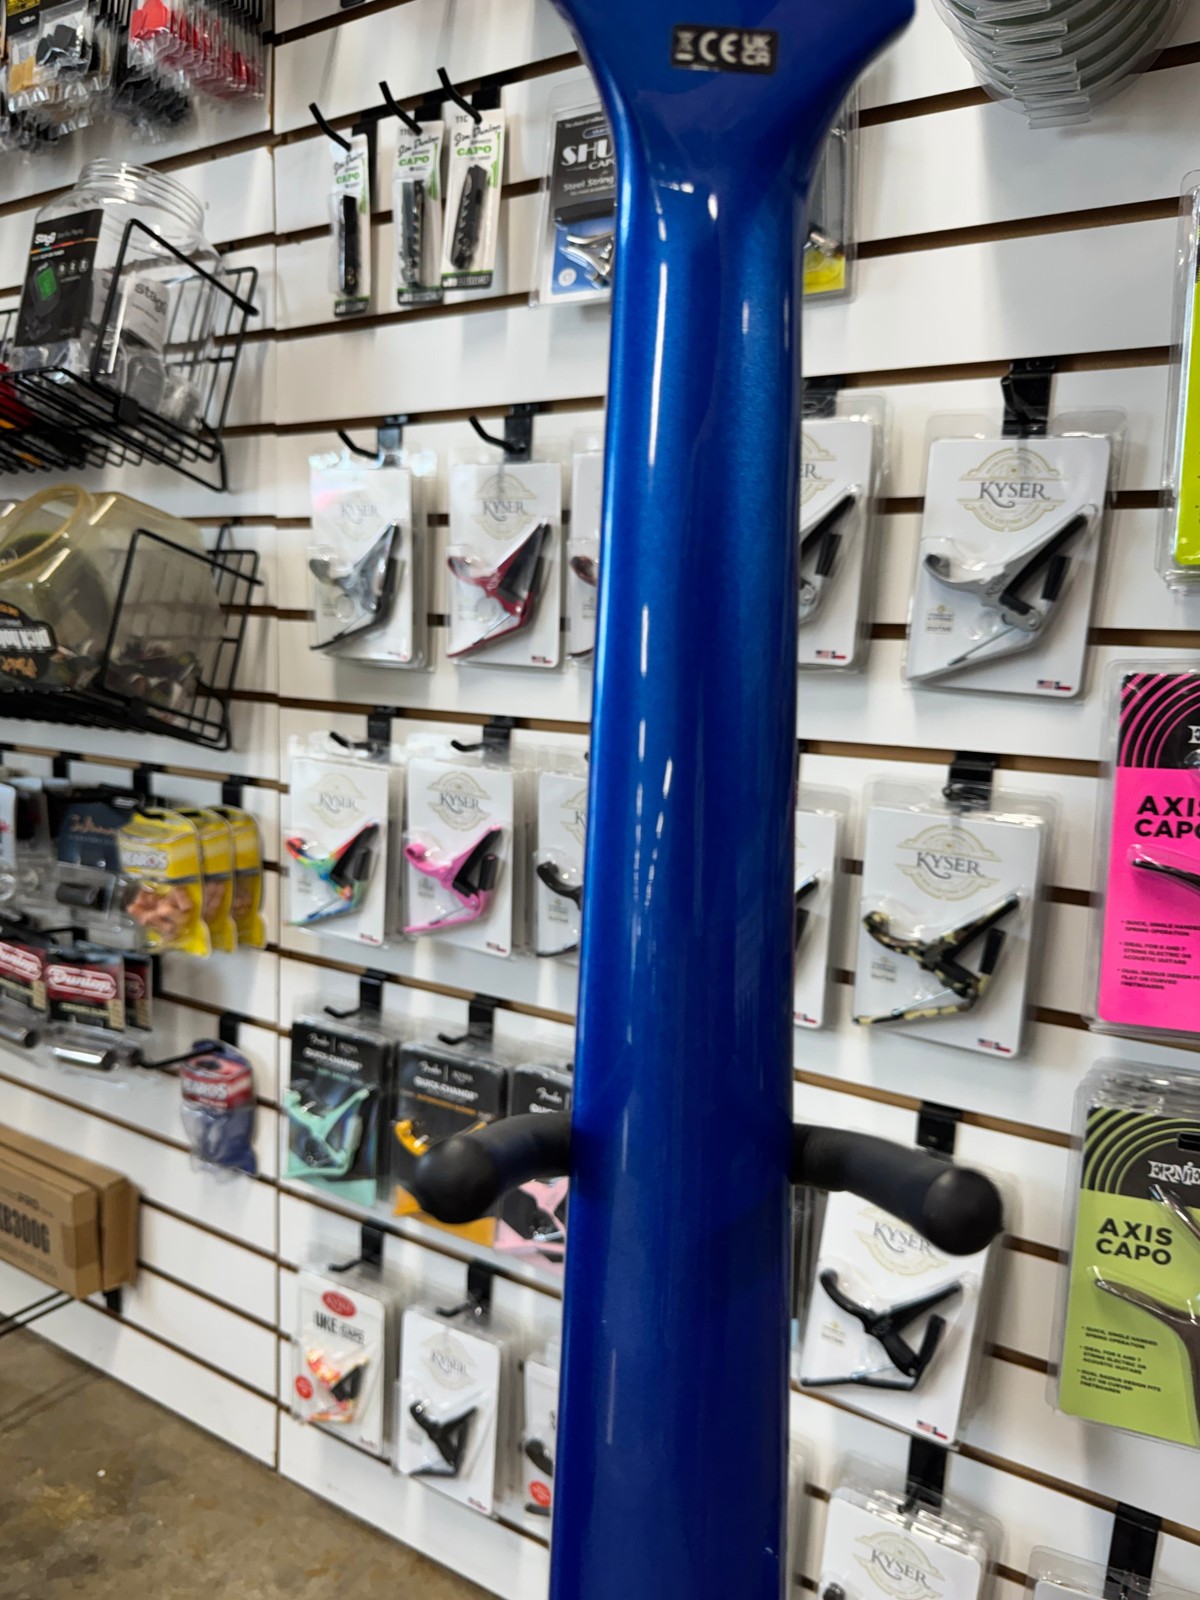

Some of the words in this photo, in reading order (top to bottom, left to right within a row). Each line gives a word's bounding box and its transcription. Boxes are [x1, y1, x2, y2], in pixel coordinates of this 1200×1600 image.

[399, 154, 430, 167] CAPO
[457, 145, 492, 157] CAPO
[561, 138, 614, 166] SHU
[979, 482, 1051, 508] KYSER
[440, 792, 482, 815] KYSER
[916, 851, 986, 880] KYSER
[873, 1221, 937, 1258] KYSER
[1098, 1217, 1173, 1247] AXIS
[1095, 1237, 1172, 1266] CAPO
[870, 1549, 932, 1591] KYSER
